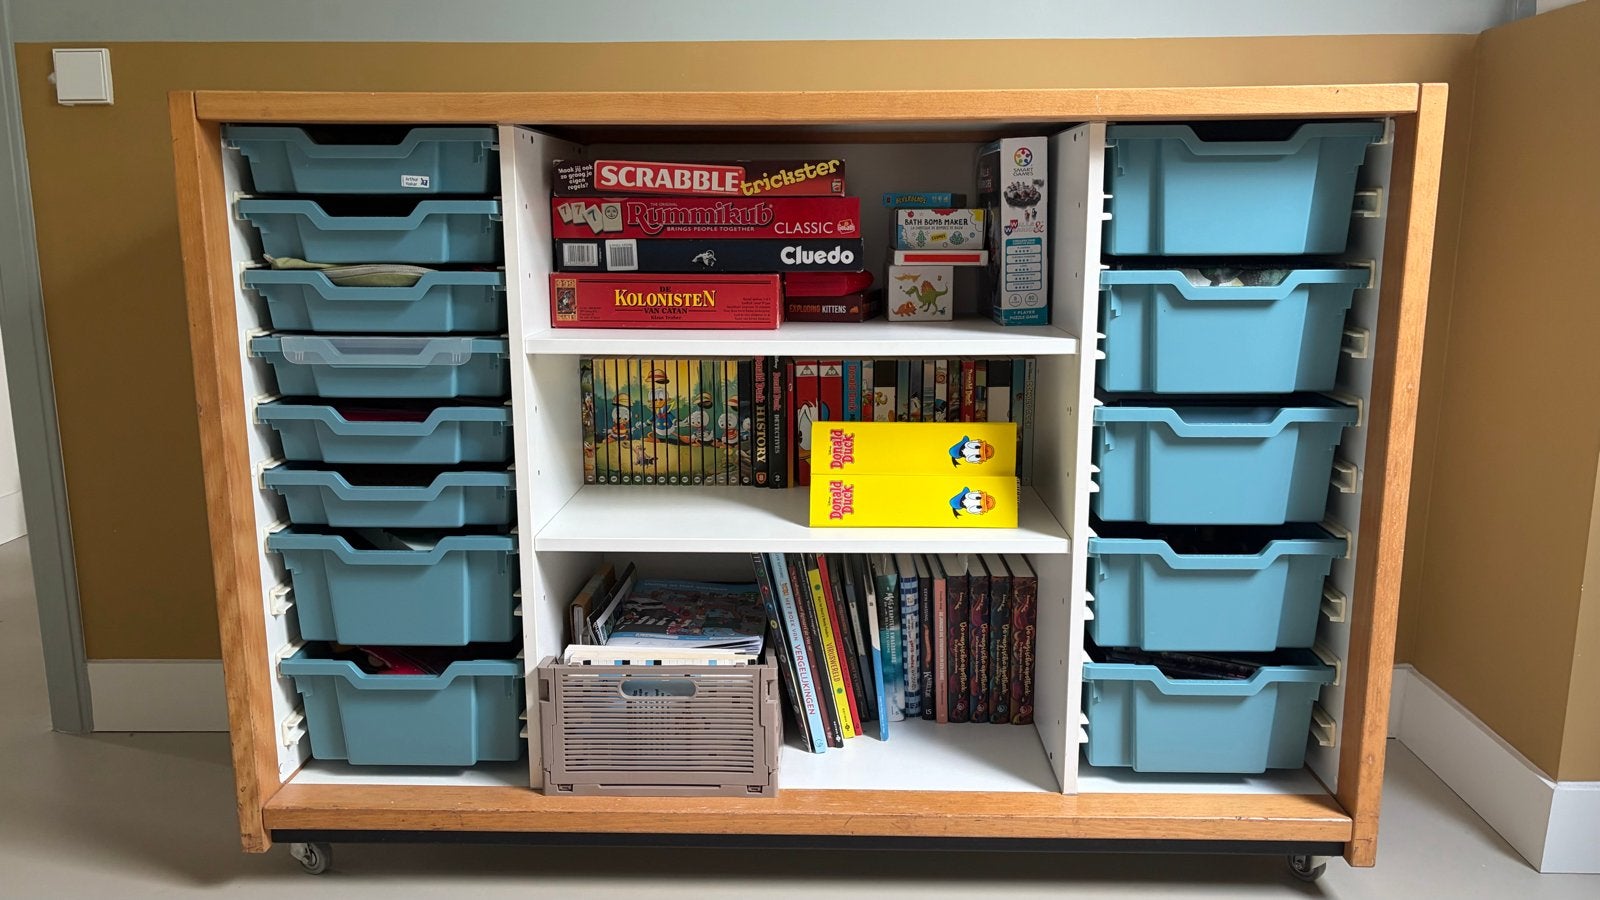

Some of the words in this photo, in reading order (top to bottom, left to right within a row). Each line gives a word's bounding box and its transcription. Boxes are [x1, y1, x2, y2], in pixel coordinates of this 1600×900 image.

[600, 165, 739, 192] SCRABBLE
[740, 159, 840, 196] trickster
[626, 202, 774, 235] Rummikub
[774, 222, 834, 234] CLASSIC
[780, 246, 855, 265] Cluedo
[614, 289, 716, 308] KOLONISTEN
[789, 304, 821, 313] EXPLODING
[822, 305, 847, 314] KITTENS
[848, 365, 857, 390] Donald
[756, 382, 765, 404] Duck
[848, 393, 857, 411] Duck
[756, 405, 766, 463] HISTORY
[830, 428, 844, 470] Donald
[842, 433, 855, 464] Duck
[829, 480, 844, 520] Donald
[842, 484, 854, 516] Duck
[960, 622, 967, 632] De
[980, 623, 988, 634] De
[1002, 623, 1010, 634] De
[1025, 624, 1033, 635] De
[826, 642, 840, 682] VIRUSWERELD
[958, 632, 966, 662] magische
[978, 634, 986, 664] magische
[999, 635, 1008, 665] magische
[1022, 636, 1031, 666] magische
[794, 644, 816, 715] VERGELIJKINGEN
[958, 663, 967, 692] apotheek
[978, 664, 987, 694] apotheek
[999, 666, 1008, 695] apotheek
[1022, 666, 1031, 697] apotheek
